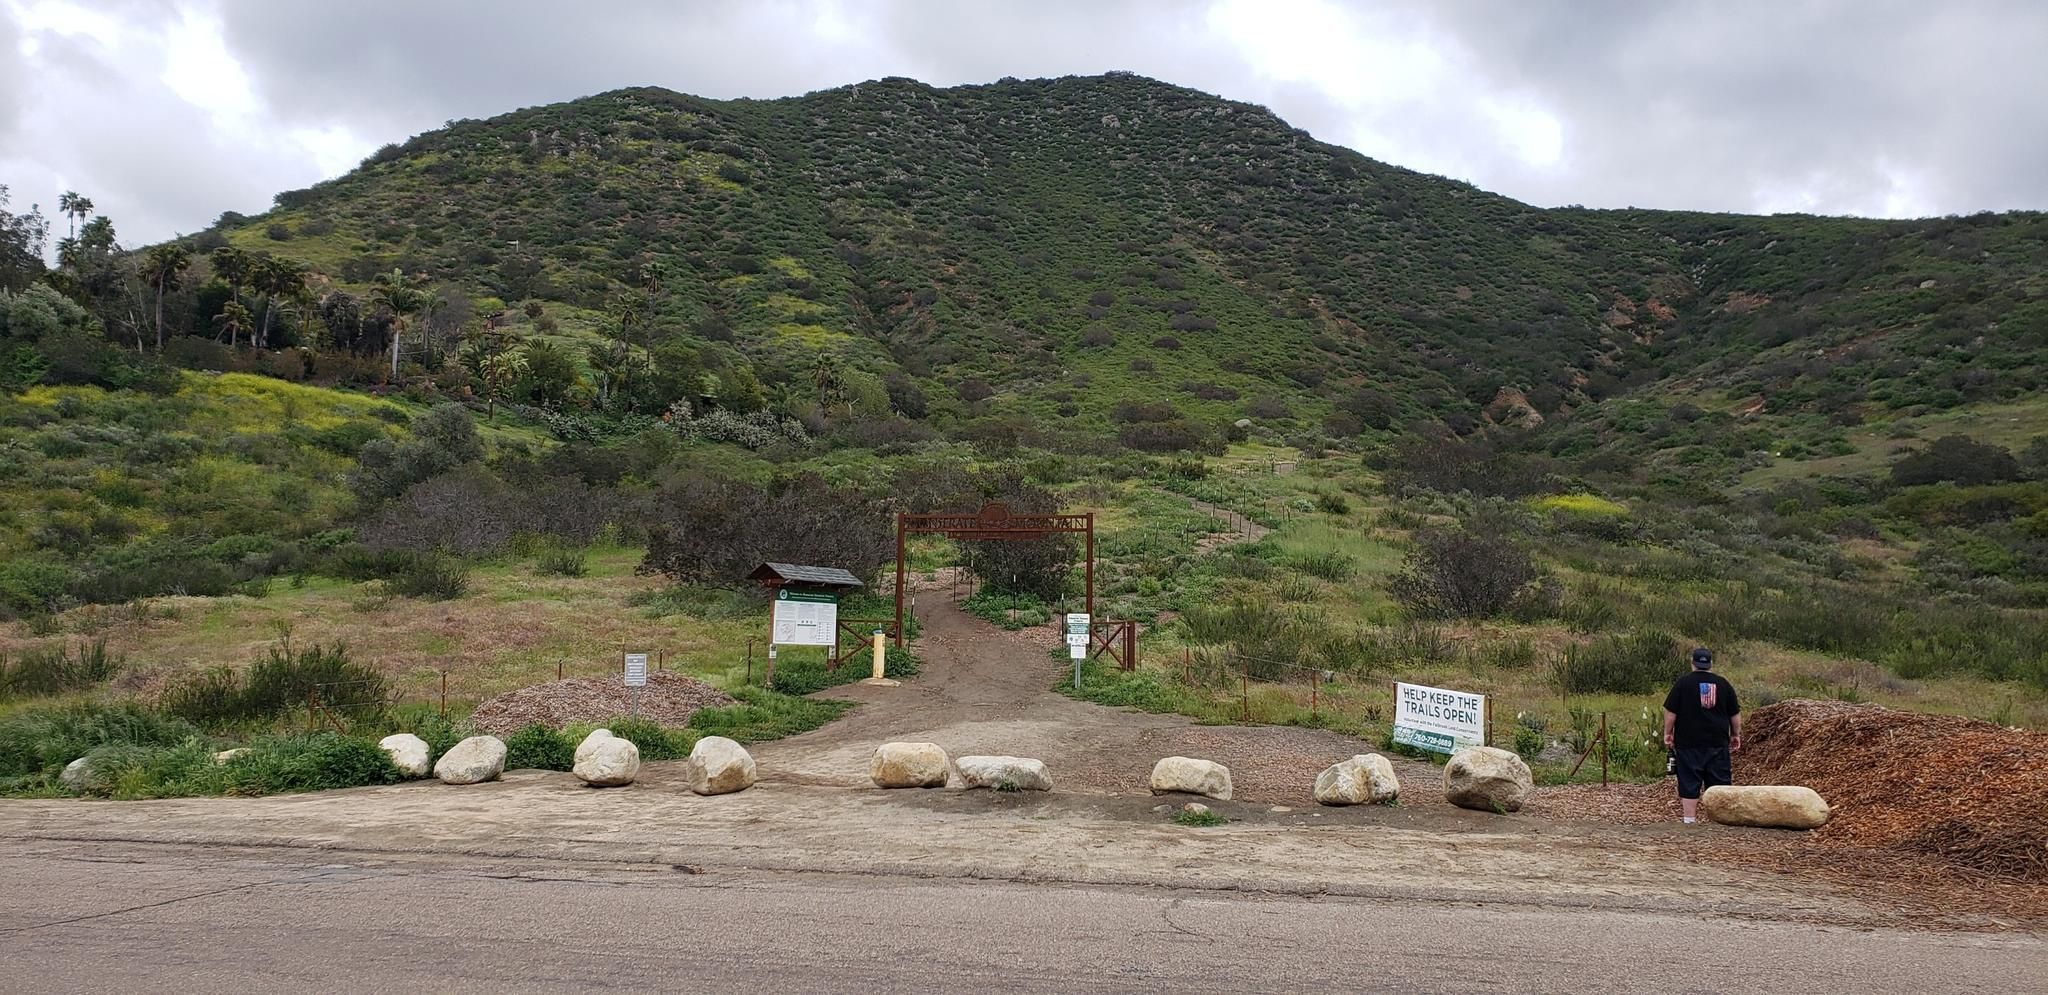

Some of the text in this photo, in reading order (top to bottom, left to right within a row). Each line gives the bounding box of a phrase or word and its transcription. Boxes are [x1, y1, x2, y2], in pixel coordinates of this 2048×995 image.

[1404, 688, 1478, 711] HELP KEEP THE
[1405, 701, 1477, 725] TRAILS OPEN!
